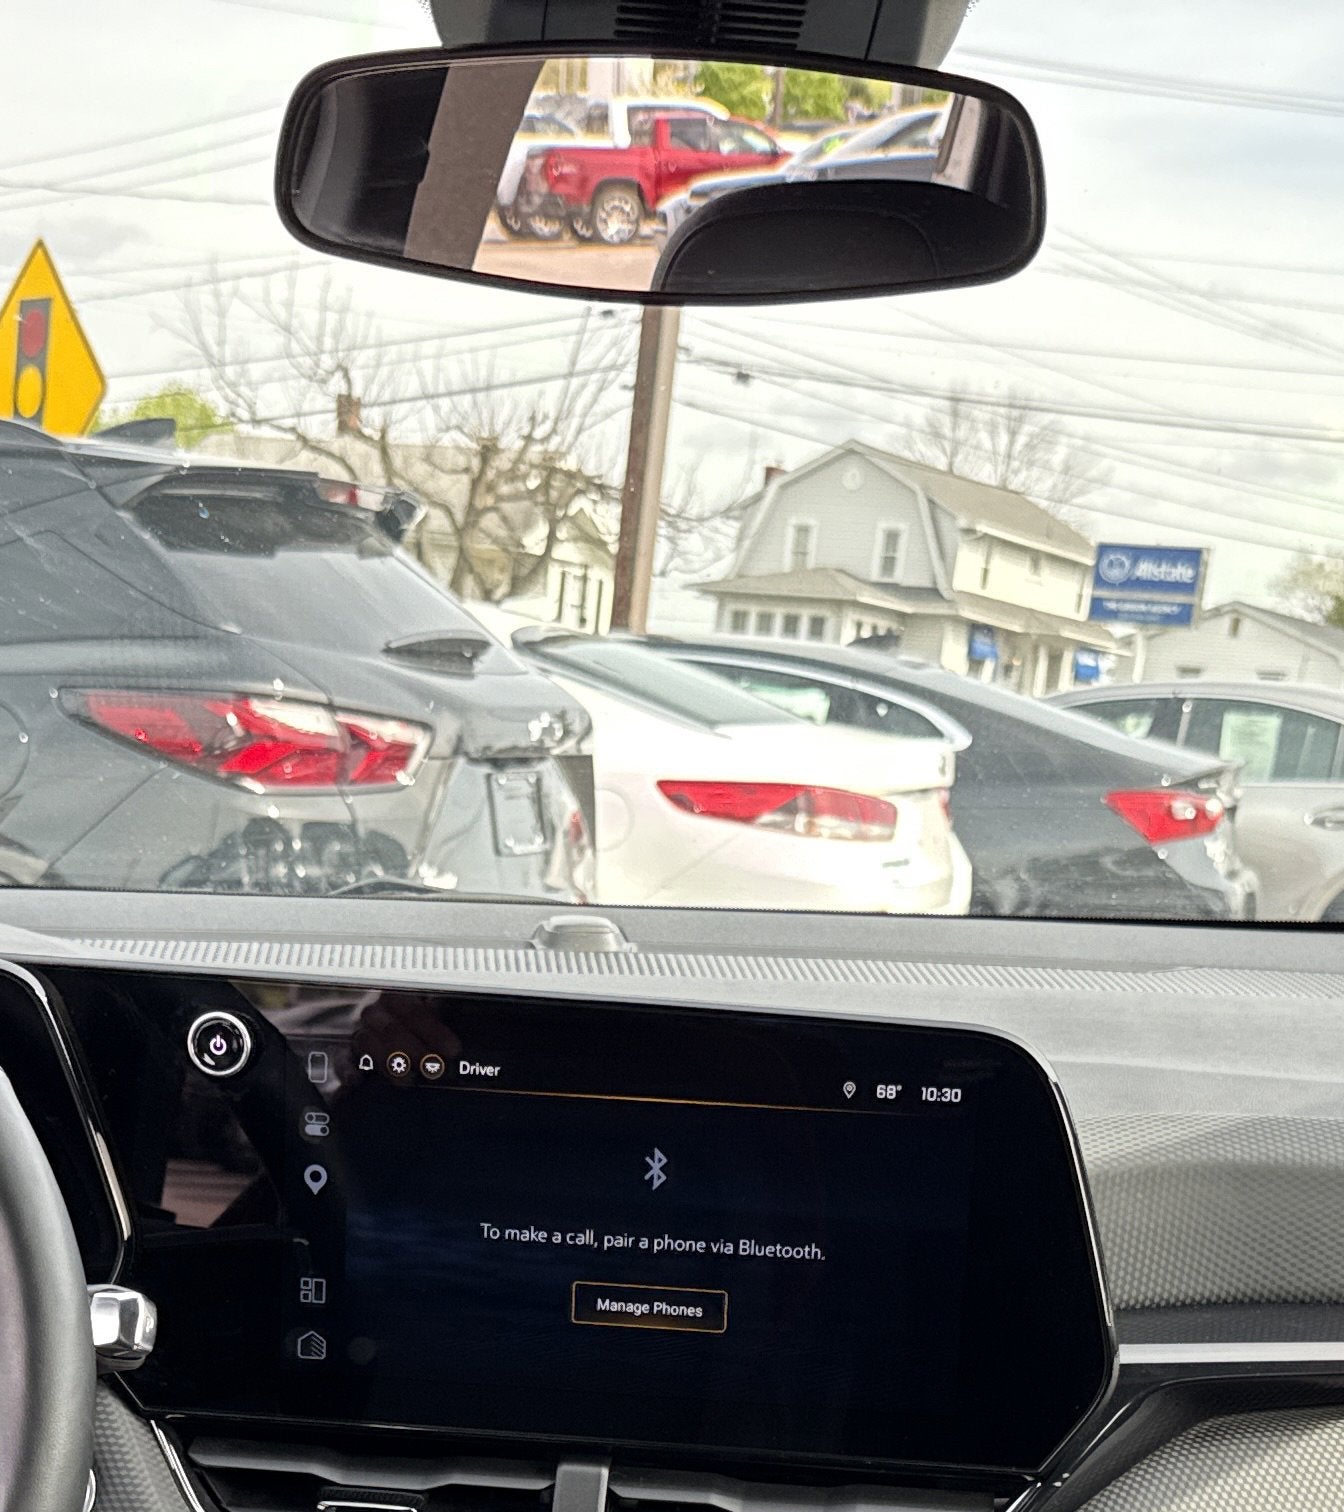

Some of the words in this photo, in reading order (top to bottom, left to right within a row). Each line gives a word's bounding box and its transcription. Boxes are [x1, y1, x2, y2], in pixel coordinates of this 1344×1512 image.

[459, 1060, 501, 1077] Driver
[876, 1084, 903, 1099] 68°
[921, 1086, 962, 1102] 10:30
[480, 1222, 501, 1240] To
[505, 1226, 548, 1243] make
[551, 1231, 562, 1244] a
[566, 1229, 599, 1248] call,
[604, 1233, 636, 1251] pair
[639, 1237, 649, 1249] a
[653, 1234, 707, 1254] phone
[710, 1239, 734, 1255] via
[739, 1239, 826, 1261] Bluetooth.
[596, 1298, 650, 1316] Manage
[653, 1301, 704, 1318] Phones
